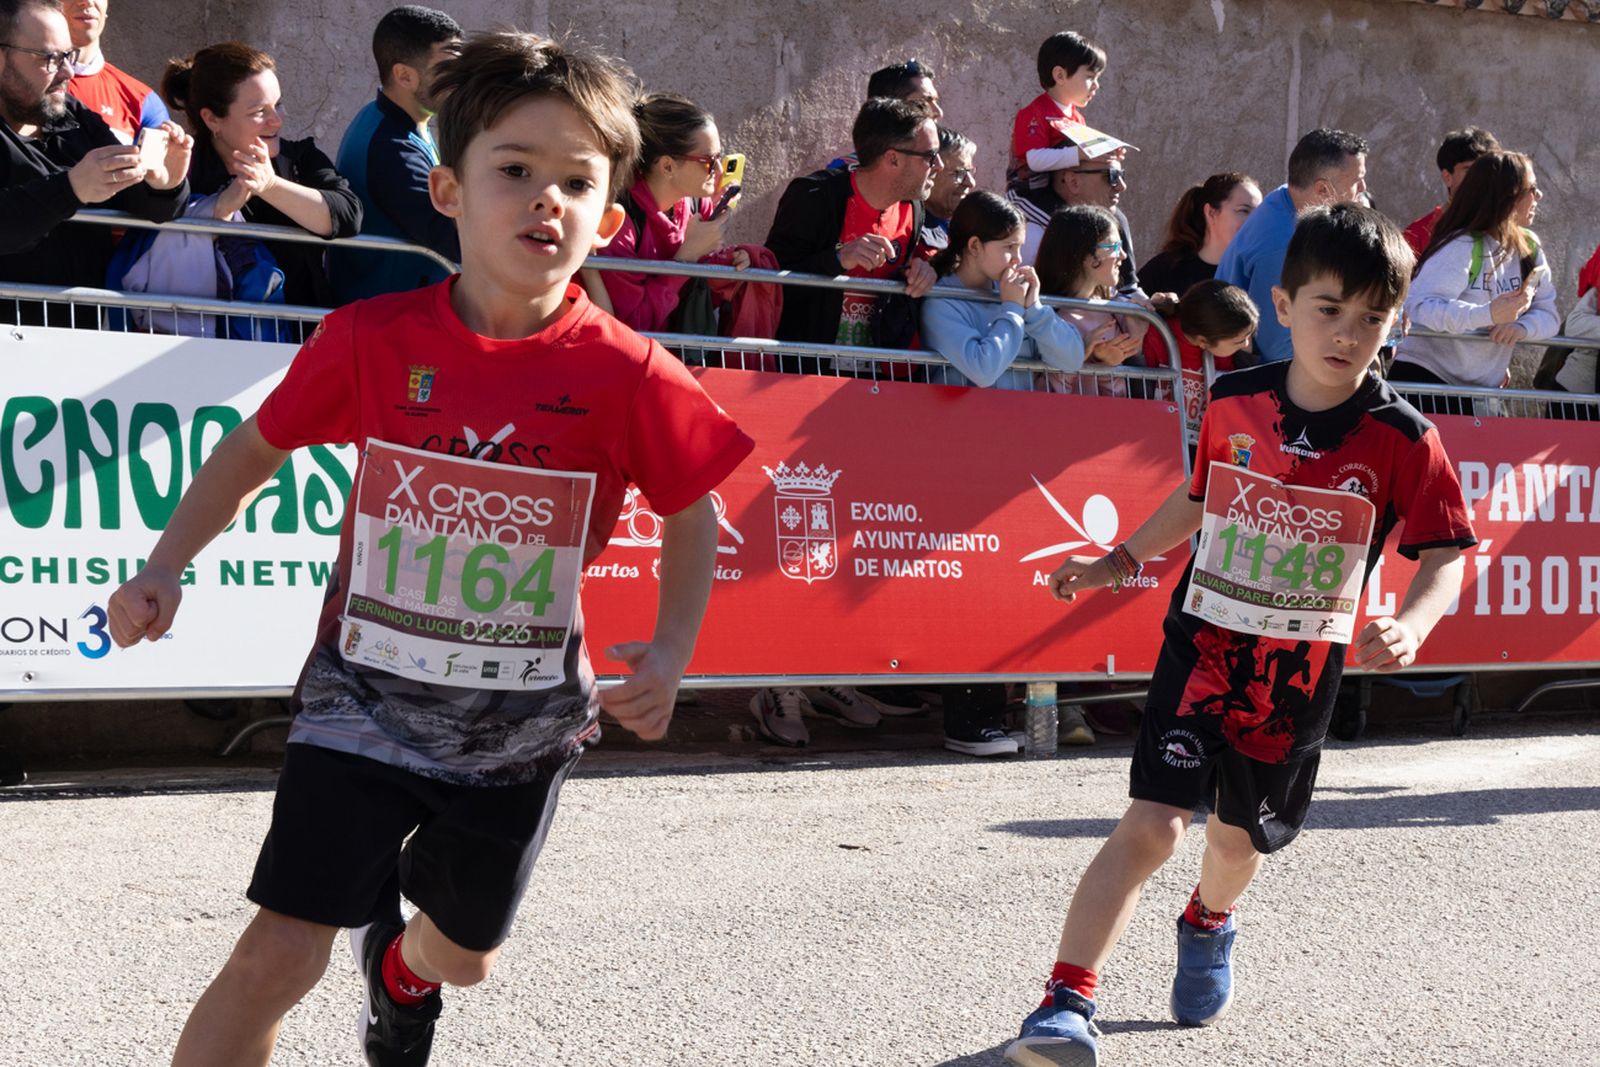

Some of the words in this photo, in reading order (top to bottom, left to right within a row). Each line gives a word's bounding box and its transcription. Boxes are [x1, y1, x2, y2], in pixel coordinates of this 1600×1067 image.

[1279, 443, 1321, 460] Vulkano
[388, 460, 425, 506] X
[429, 483, 554, 526] CROSS
[1231, 477, 1256, 512] X
[1256, 497, 1343, 531] CROSS
[850, 502, 923, 523] EXCMO.
[384, 503, 522, 550] PANTANO
[526, 533, 549, 547] DEL
[1226, 508, 1319, 547] PANTANO
[1322, 535, 1339, 544] DEL
[852, 530, 1000, 552] AYUNTAMIENTO
[854, 558, 880, 577] DE
[883, 559, 963, 579] MARTOS
[1219, 523, 1345, 591] 1148
[378, 526, 556, 617] 1164
[586, 563, 640, 579] artos
[1194, 572, 1234, 595] ALVARO
[1443, 539, 1600, 616] ÍBOR
[350, 597, 413, 627] FERNANDO
[416, 617, 469, 636] LUQUE
[404, 600, 457, 617] MARTOS
[1, 616, 68, 643] ON
[1162, 751, 1201, 768] Martos
